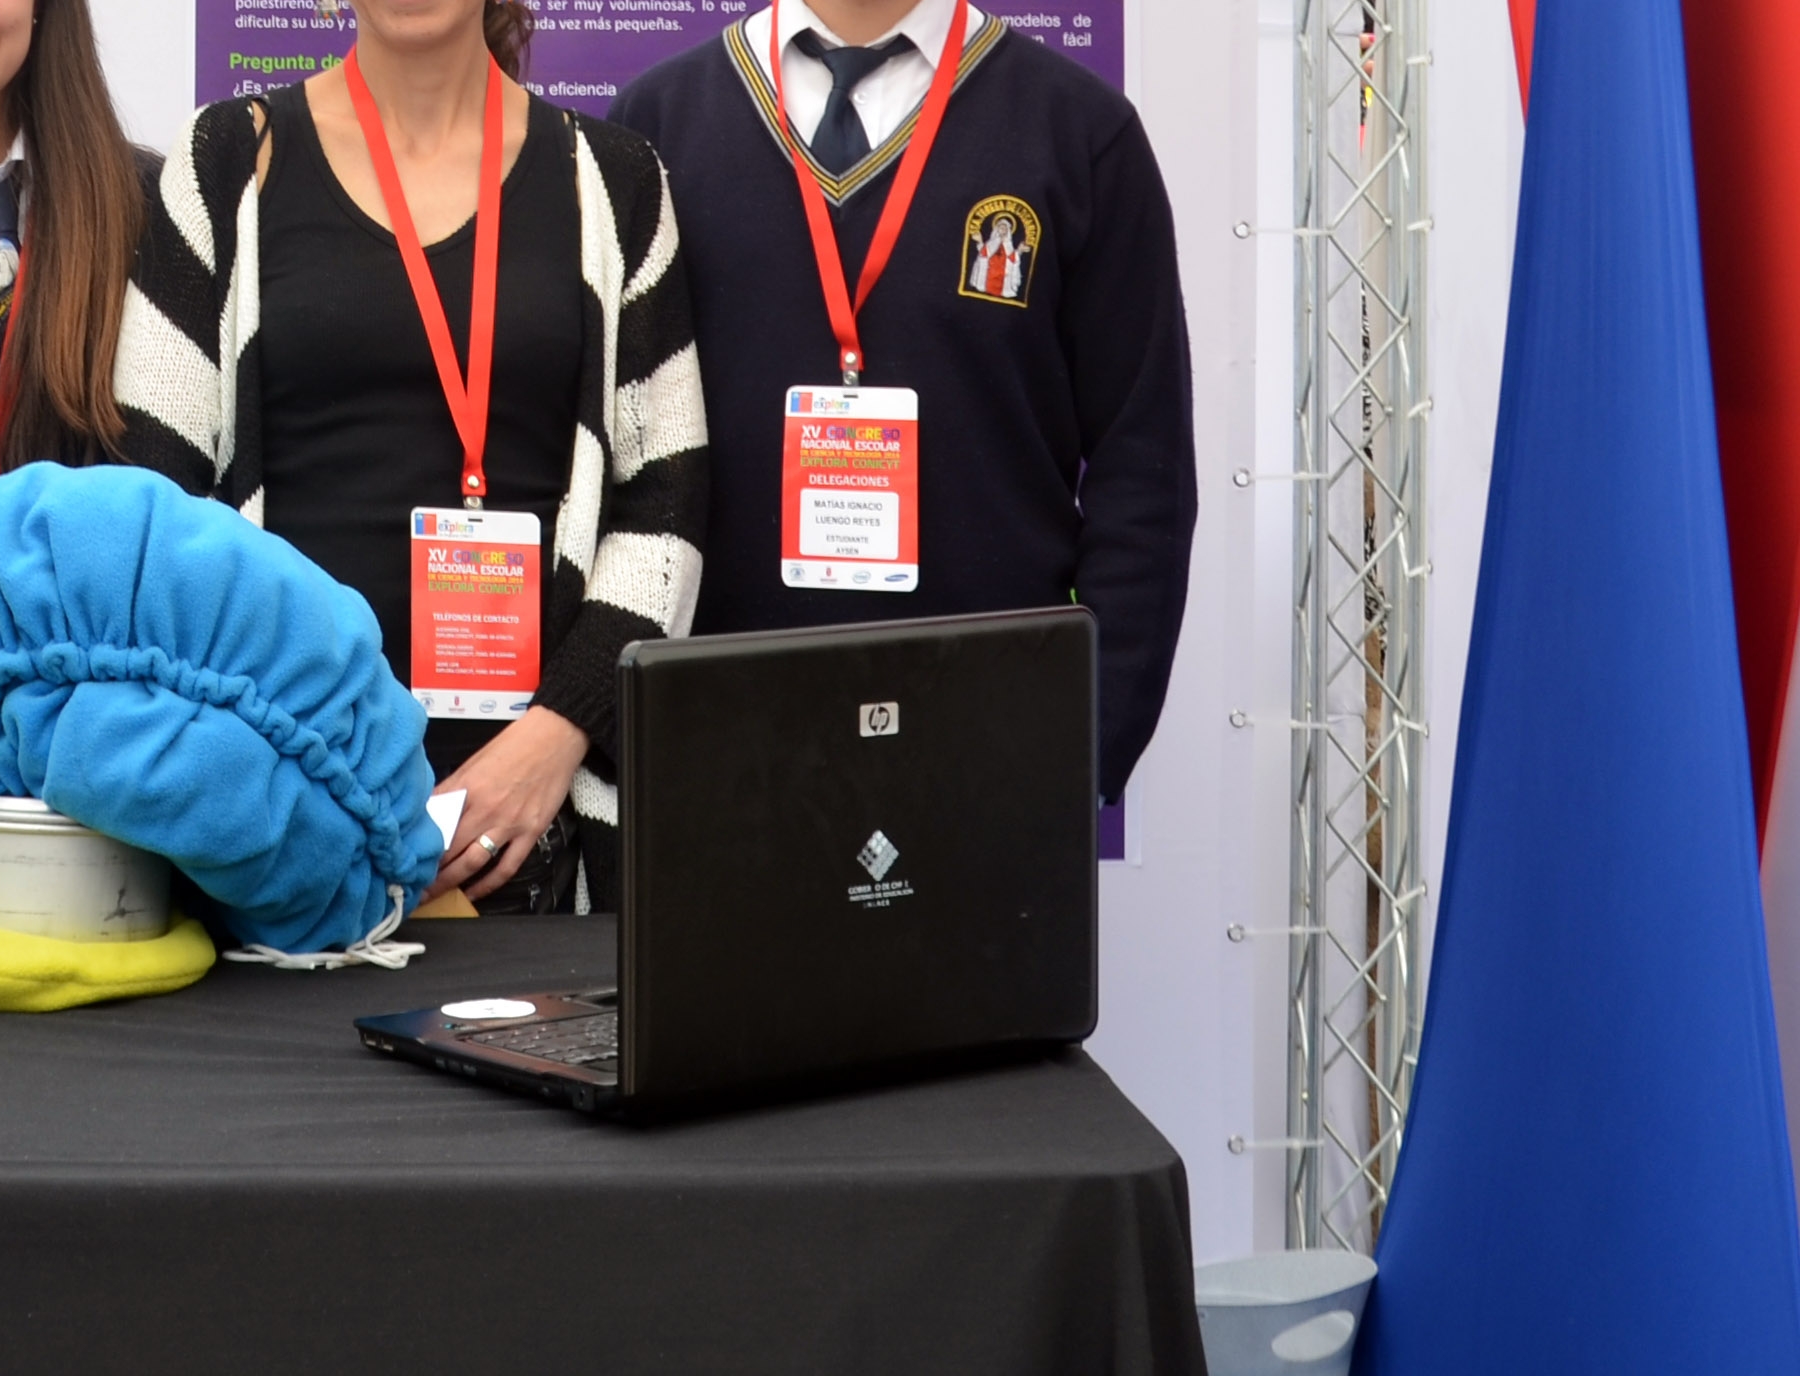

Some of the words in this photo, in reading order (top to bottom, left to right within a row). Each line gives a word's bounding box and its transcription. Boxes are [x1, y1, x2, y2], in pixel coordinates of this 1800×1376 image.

[547, 0, 568, 11] ser
[574, 0, 603, 14] muy
[721, 1, 746, 14] que
[235, 14, 289, 29] dificulta
[291, 17, 307, 29] su
[310, 17, 334, 29] uso
[337, 17, 345, 31] y
[559, 19, 581, 30] vez
[584, 17, 611, 30] más
[615, 17, 683, 33] pequeñas.
[1000, 13, 1061, 28] modelos
[1073, 13, 1092, 28] de
[230, 53, 315, 73] Pregunta
[548, 81, 617, 96] eficiencia
[802, 425, 822, 439] XV
[826, 426, 901, 441] CONGRESO
[801, 439, 853, 451] NACIONAL
[854, 440, 901, 452] ESCOLAR
[809, 473, 890, 487] DELEGACIONES
[815, 516, 851, 526] LUENGO
[852, 518, 881, 527] REYES
[428, 547, 447, 562] XV
[452, 549, 525, 566] CONGRESO
[428, 562, 478, 575] NACIONAL
[480, 565, 524, 577] ESCOLAR
